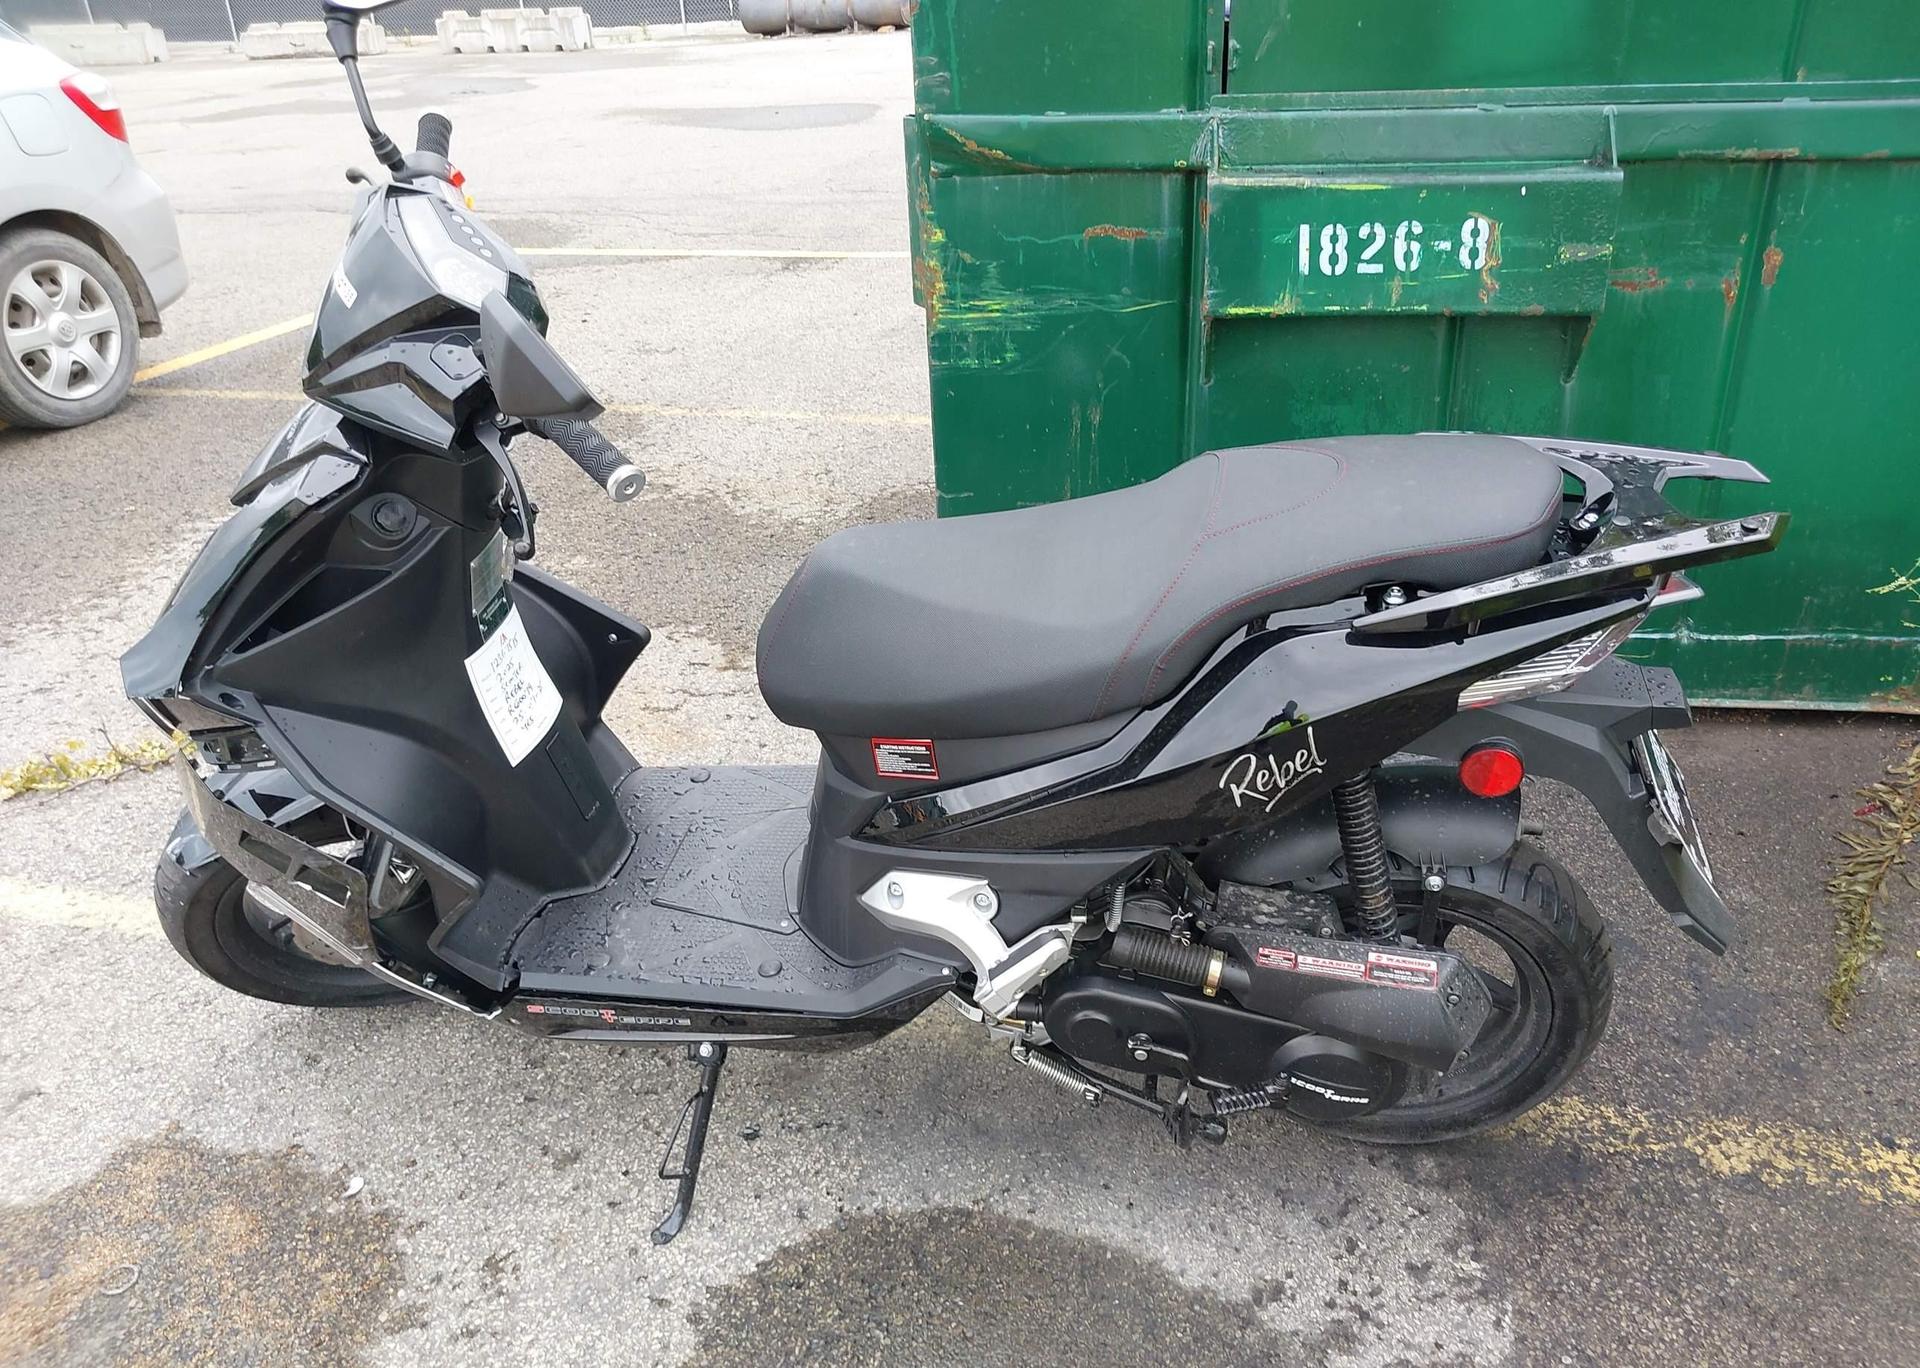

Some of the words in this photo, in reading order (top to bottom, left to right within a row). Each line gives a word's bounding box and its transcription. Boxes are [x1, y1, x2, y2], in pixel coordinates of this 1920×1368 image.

[1298, 216, 1490, 276] 1826-8
[1218, 725, 1327, 809] Rebel
[1311, 958, 1362, 970] WARNING
[1386, 956, 1432, 968] WARNING
